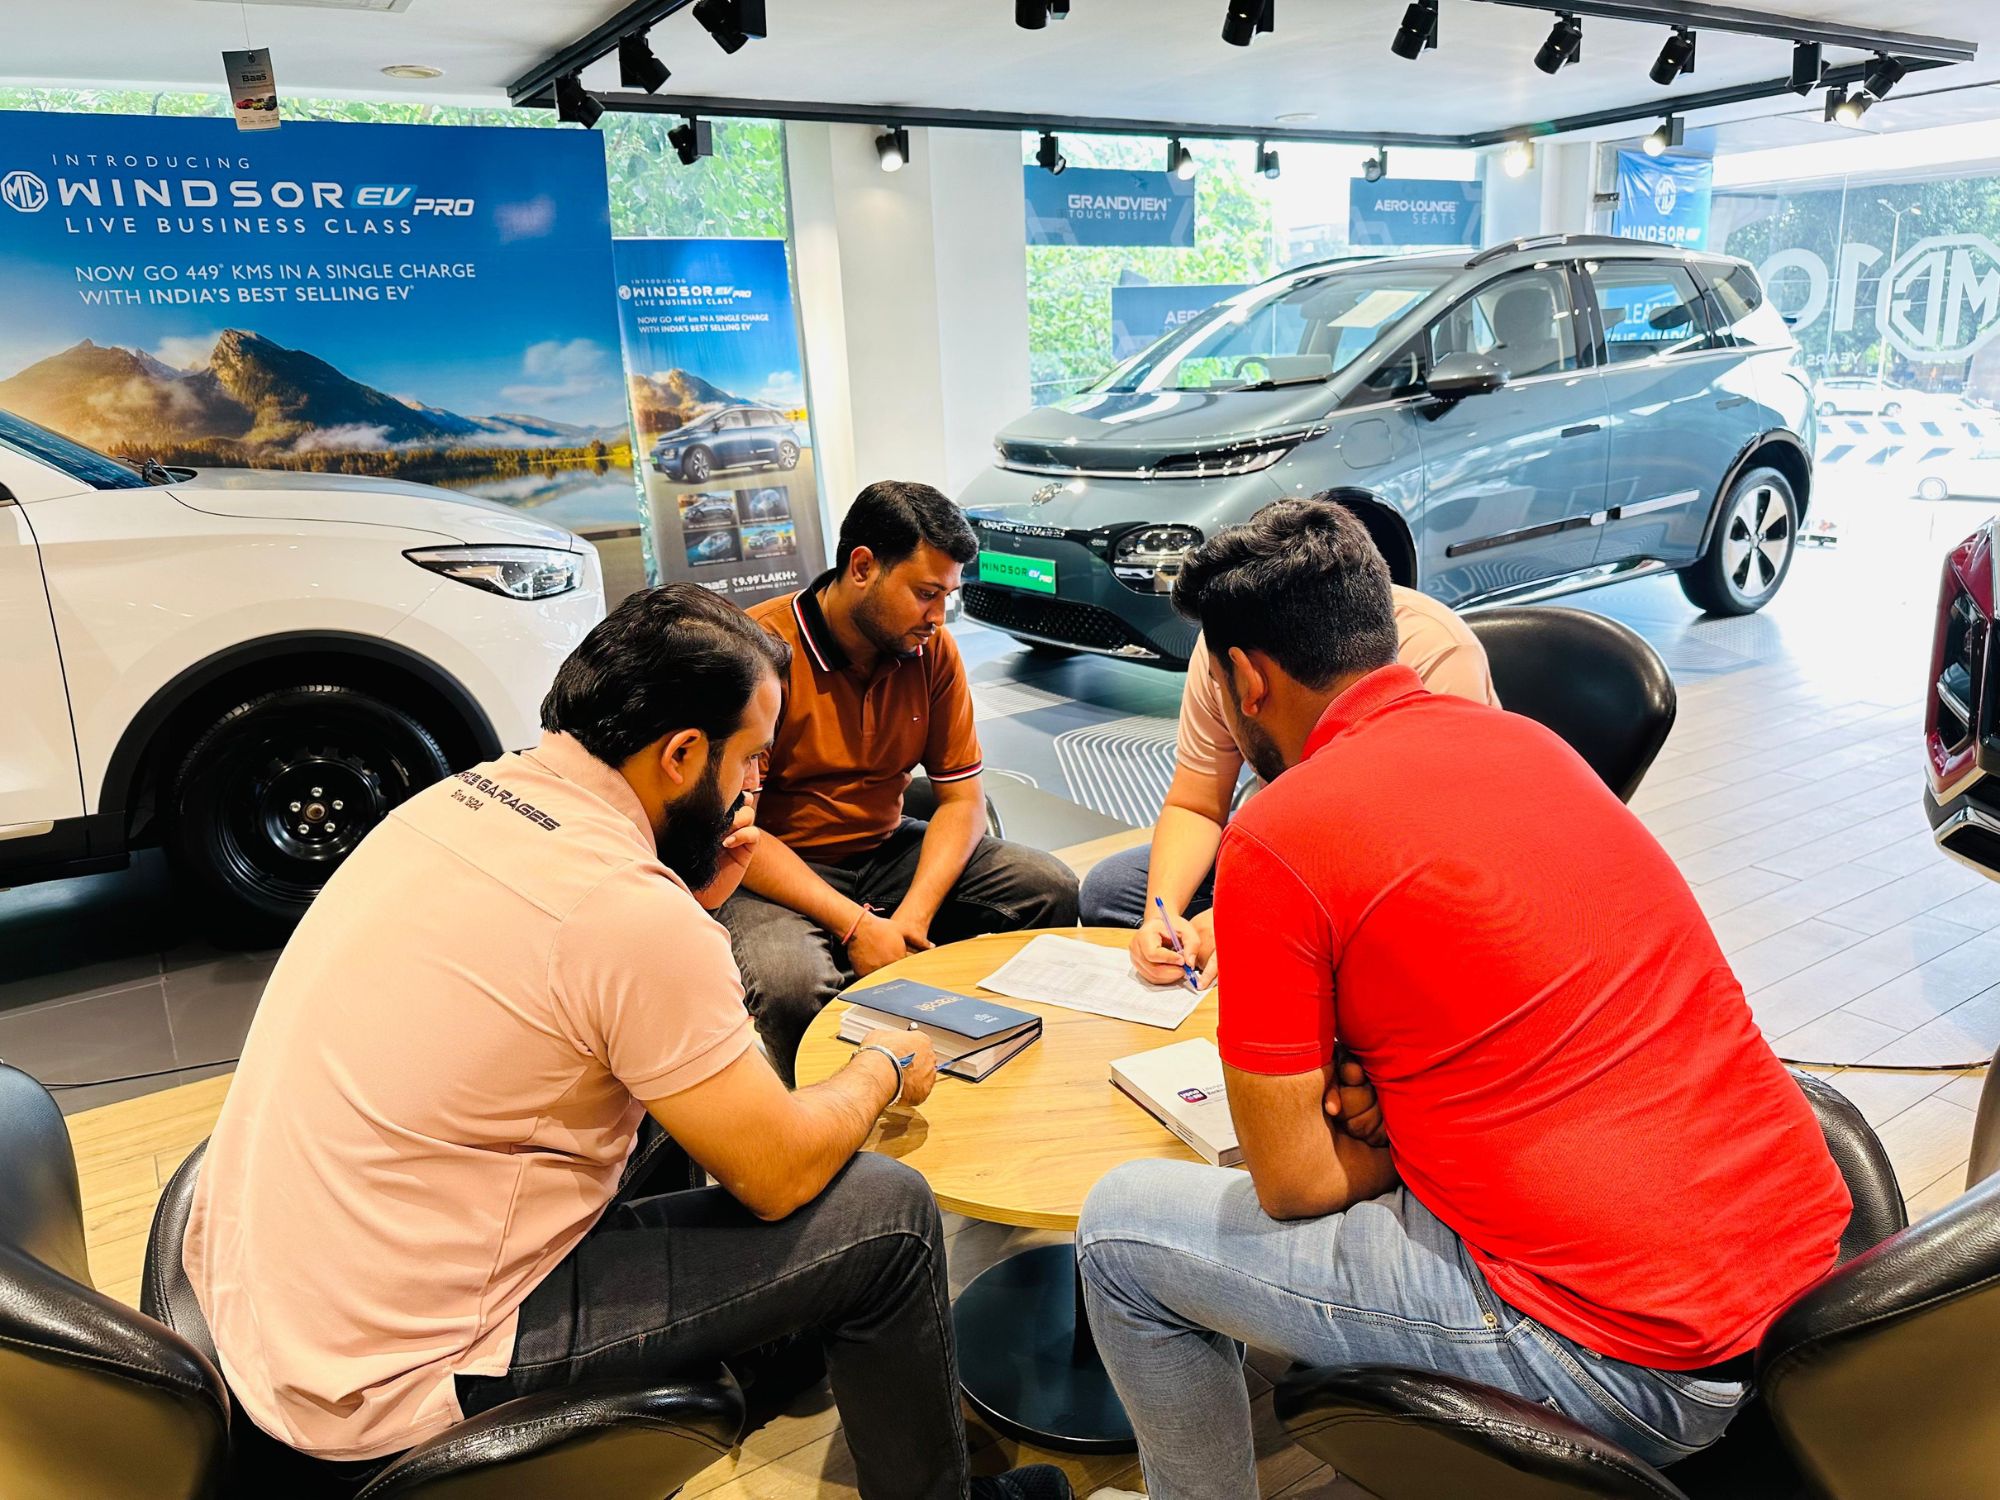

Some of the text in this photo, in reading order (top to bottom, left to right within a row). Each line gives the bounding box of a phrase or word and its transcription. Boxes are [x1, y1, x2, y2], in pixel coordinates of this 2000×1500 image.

[52, 154, 250, 169] INTRODUCING
[3, 172, 475, 217] MG WINDSOR EV PRO
[1069, 210, 1167, 221] TOUCH DISPLAY
[1412, 213, 1456, 225] SEATS
[65, 217, 412, 235] LIVE BUSINESS CLASS
[1621, 225, 1685, 242] WINDSOR
[75, 265, 135, 282] NOW
[143, 265, 178, 281] GO
[232, 265, 273, 281] KMS
[279, 264, 302, 280] IN
[307, 264, 321, 280] A
[326, 264, 394, 280] SINGLE
[399, 263, 476, 278] CHARGE
[79, 289, 142, 305] WITH
[149, 287, 231, 305] INDIA'S
[238, 287, 288, 303] BEST
[295, 286, 380, 302] SELLING
[633, 285, 713, 298] WINDSOR
[732, 289, 752, 299] PRO
[634, 297, 734, 307] LIVE BUSINESS CLASS
[637, 317, 658, 325] NOW
[659, 316, 672, 324] GO
[715, 313, 741, 322] SINGLE
[741, 313, 769, 322] CHARGE
[639, 325, 660, 334] WITH
[690, 324, 709, 332] BEST
[709, 322, 741, 332] SELLING
[981, 561, 1028, 577] WINDSOR
[476, 778, 562, 832] GARAGES
